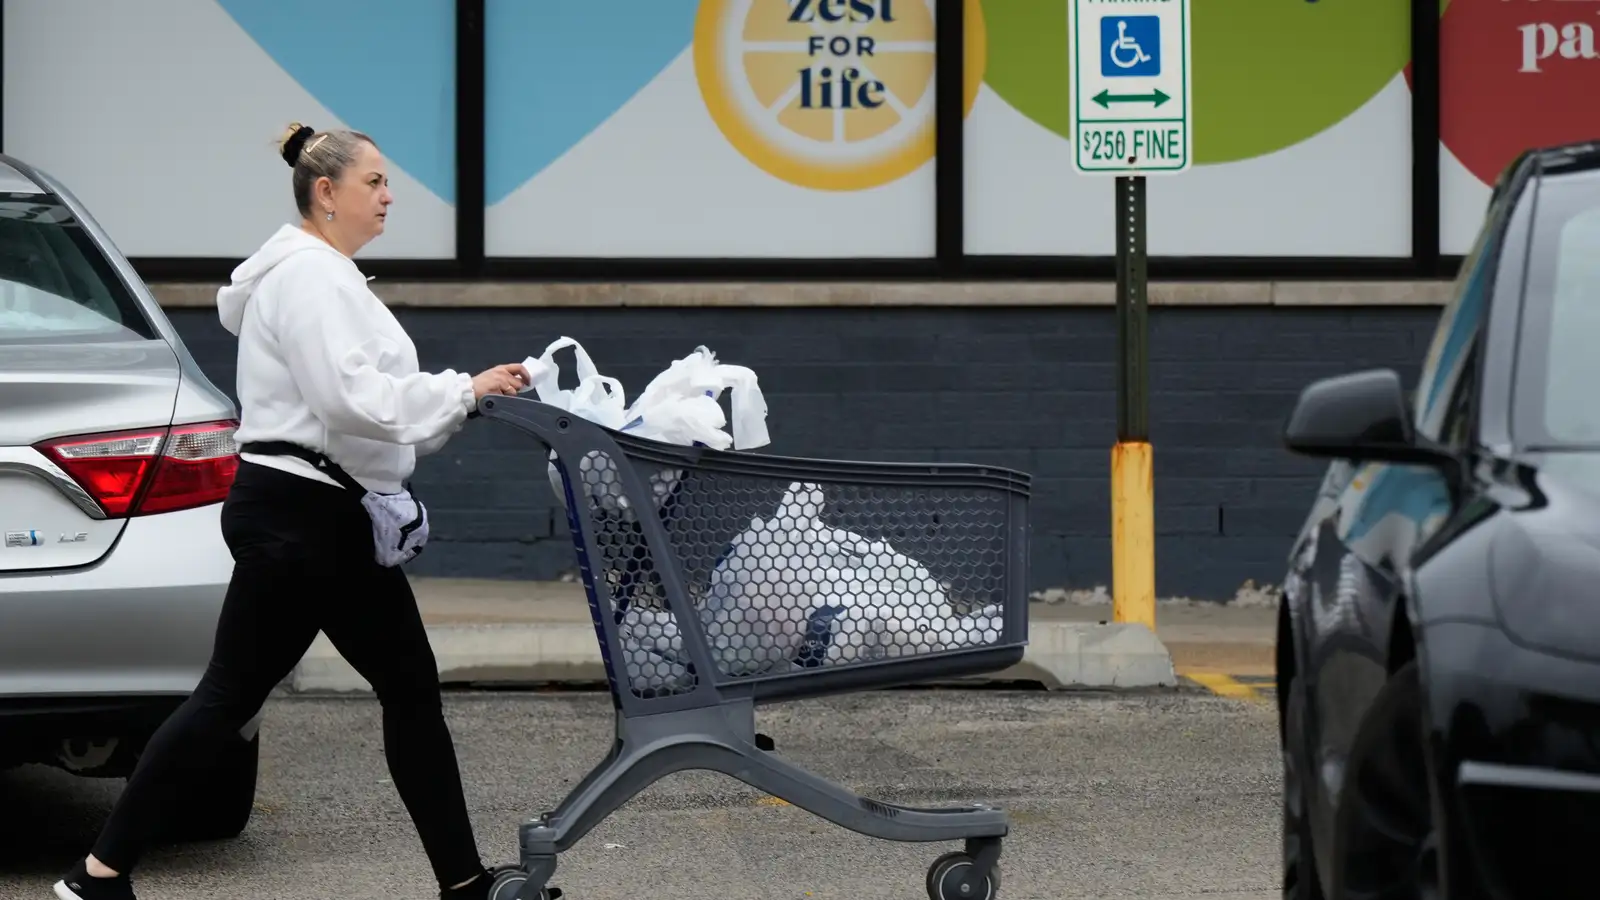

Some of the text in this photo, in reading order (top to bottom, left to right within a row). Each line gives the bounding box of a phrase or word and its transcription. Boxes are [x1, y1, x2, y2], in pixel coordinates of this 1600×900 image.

[808, 36, 875, 56] FOR
[1517, 12, 1600, 73] pa
[798, 67, 886, 109] life
[1084, 129, 1180, 160] $250 FINE
